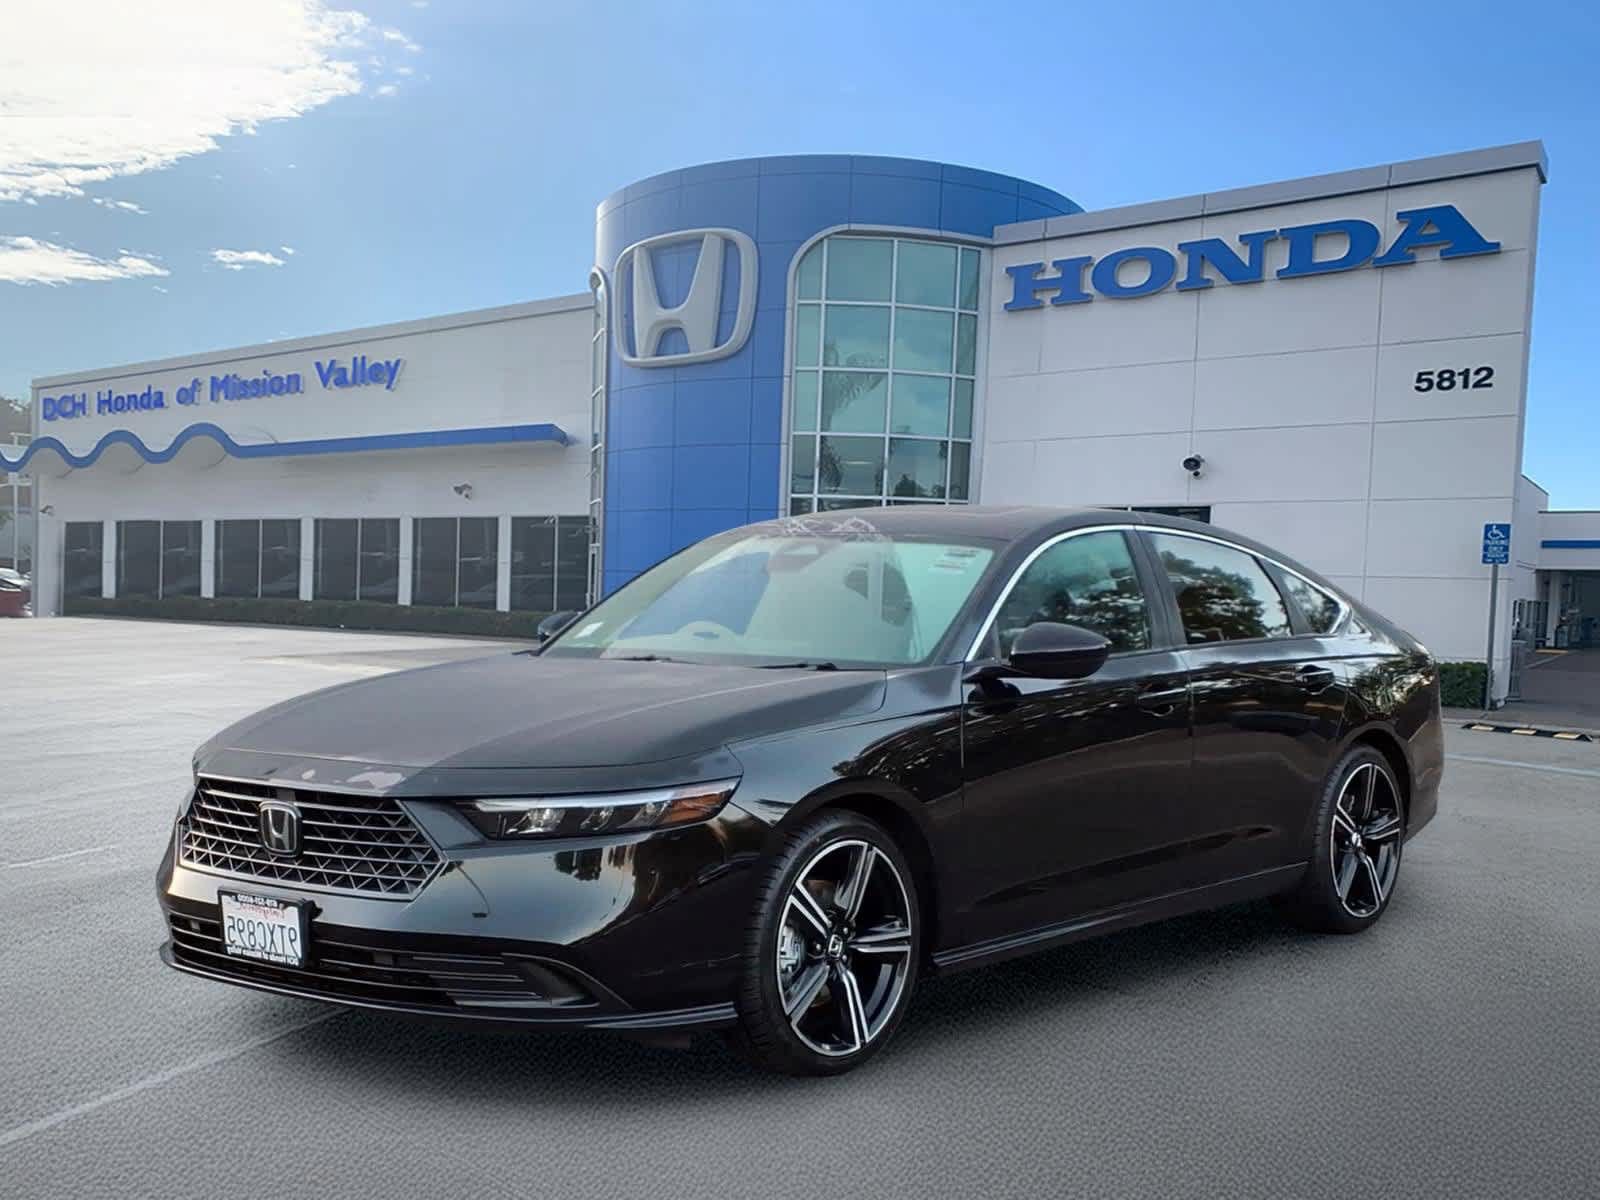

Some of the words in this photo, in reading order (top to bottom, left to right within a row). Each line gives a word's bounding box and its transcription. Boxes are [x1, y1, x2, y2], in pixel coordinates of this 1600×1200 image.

[1003, 204, 1501, 311] HONDA
[42, 393, 87, 421] DCH
[97, 385, 165, 414] Honda
[176, 377, 203, 405] of
[210, 370, 303, 402] Mission
[314, 355, 401, 391] Valley
[1414, 366, 1495, 392] 5812
